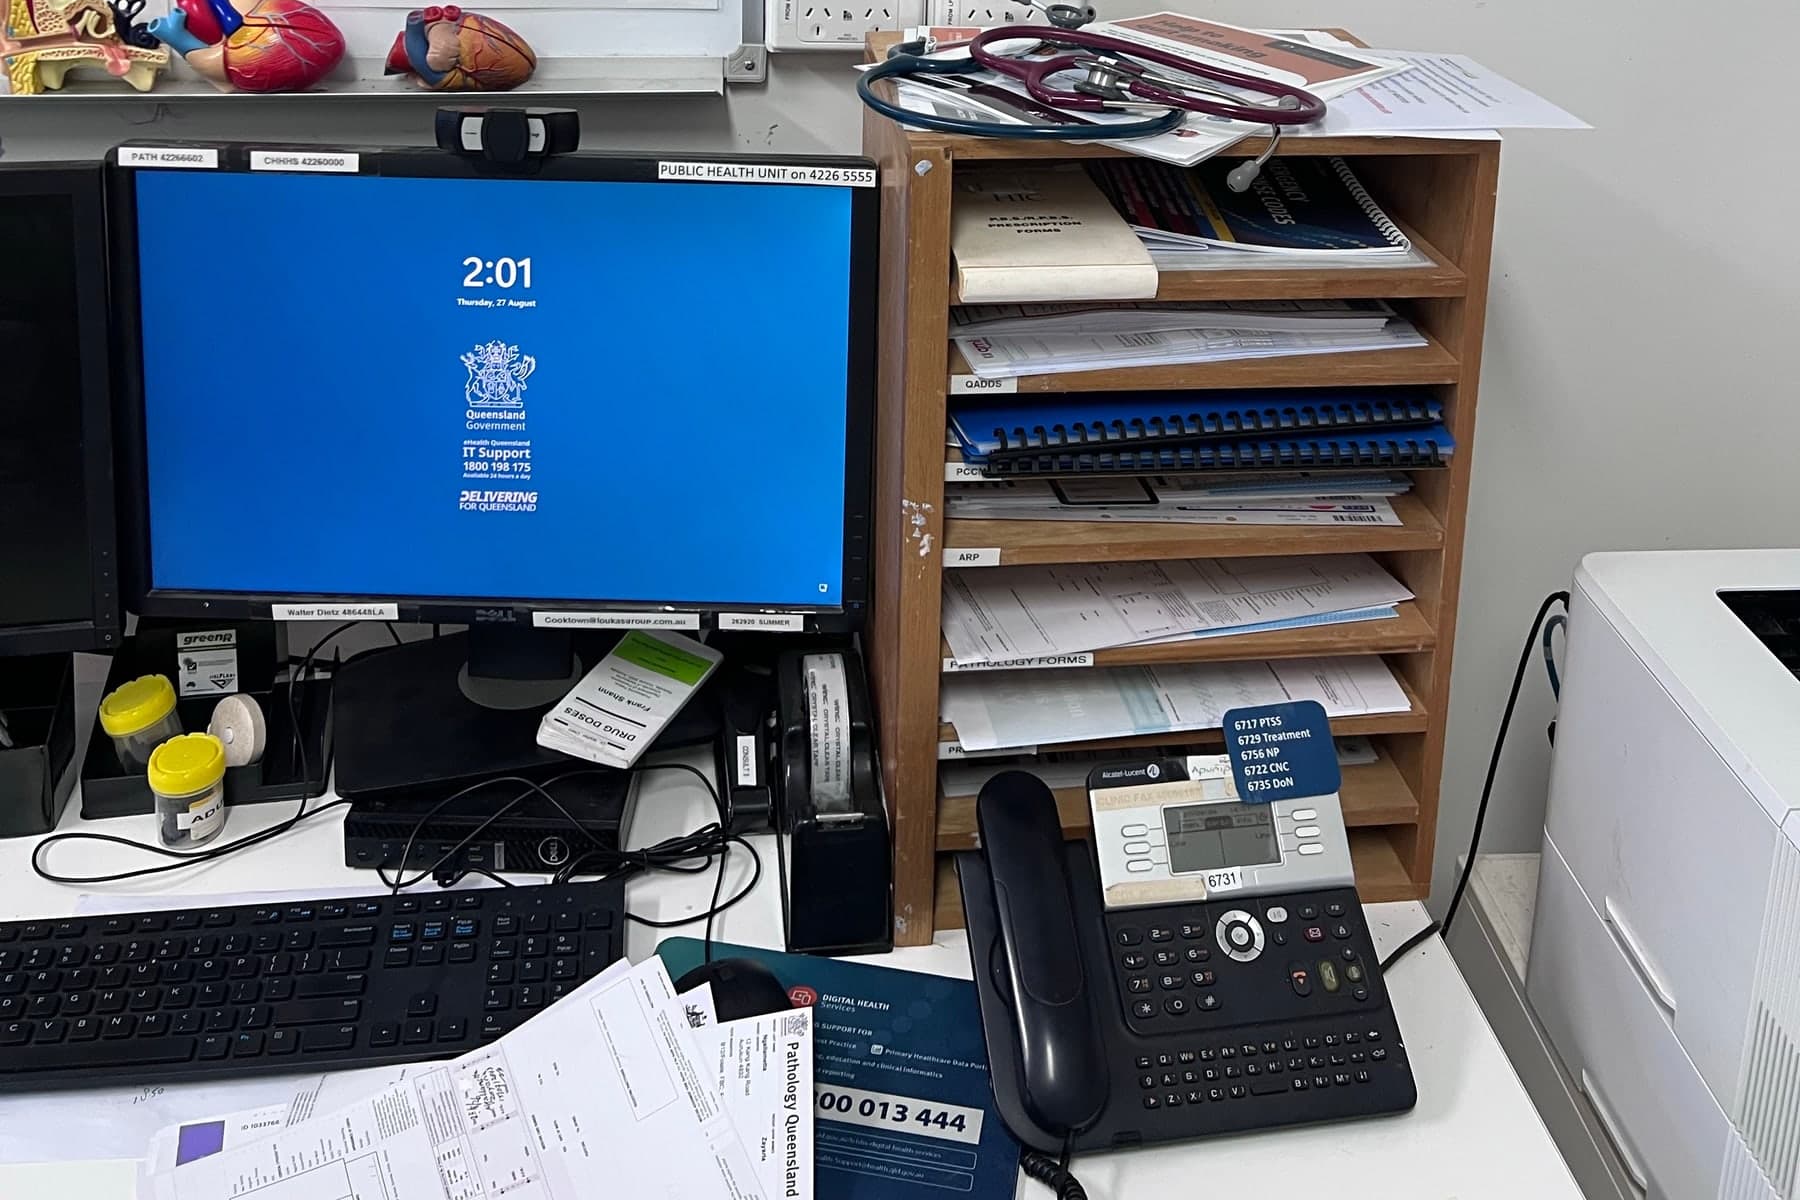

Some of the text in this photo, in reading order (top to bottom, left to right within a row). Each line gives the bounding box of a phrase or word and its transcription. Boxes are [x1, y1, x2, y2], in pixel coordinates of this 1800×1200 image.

[131, 153, 158, 161] PATH
[660, 164, 873, 182] PUBLIC HEALTH UNIT on 4226 5555
[463, 256, 532, 289] 2:01
[457, 297, 537, 309] Thursday, 27 August
[965, 379, 1002, 388] QADDS
[466, 409, 526, 420] Queensland
[466, 420, 526, 431] Government
[462, 447, 531, 461] IT Support
[463, 461, 532, 472] 1800 198 175
[460, 490, 538, 504] DELIVERING
[459, 502, 537, 513] FOR QUEENSLAND
[959, 553, 980, 561] ARP
[317, 608, 339, 616] Dietz
[758, 619, 791, 627] SUMMER
[1038, 655, 1087, 665] FORMS
[598, 686, 652, 712] Frank Shann
[563, 706, 637, 742] DRUG DOSES
[1234, 716, 1282, 731] 6717 PTSS
[1237, 728, 1311, 746] 6729 Treatment
[1241, 747, 1280, 761] 6756 NP
[1102, 768, 1146, 779] Alcatel-Lucent
[1244, 761, 1289, 776] 6722 CNC
[1247, 776, 1294, 792] 6735 DoN
[1208, 872, 1236, 888] 6731
[820, 1002, 856, 1013] Services
[822, 994, 890, 1011] DIGITAL HEALTH
[821, 1023, 873, 1037] SUPPORT FOR
[885, 1048, 969, 1068] Primary Healthcare Data
[825, 1055, 944, 1079] education and clinical informatics
[784, 1041, 800, 1198] Pathology Queensland
[815, 1092, 967, 1133] 00 013 444
